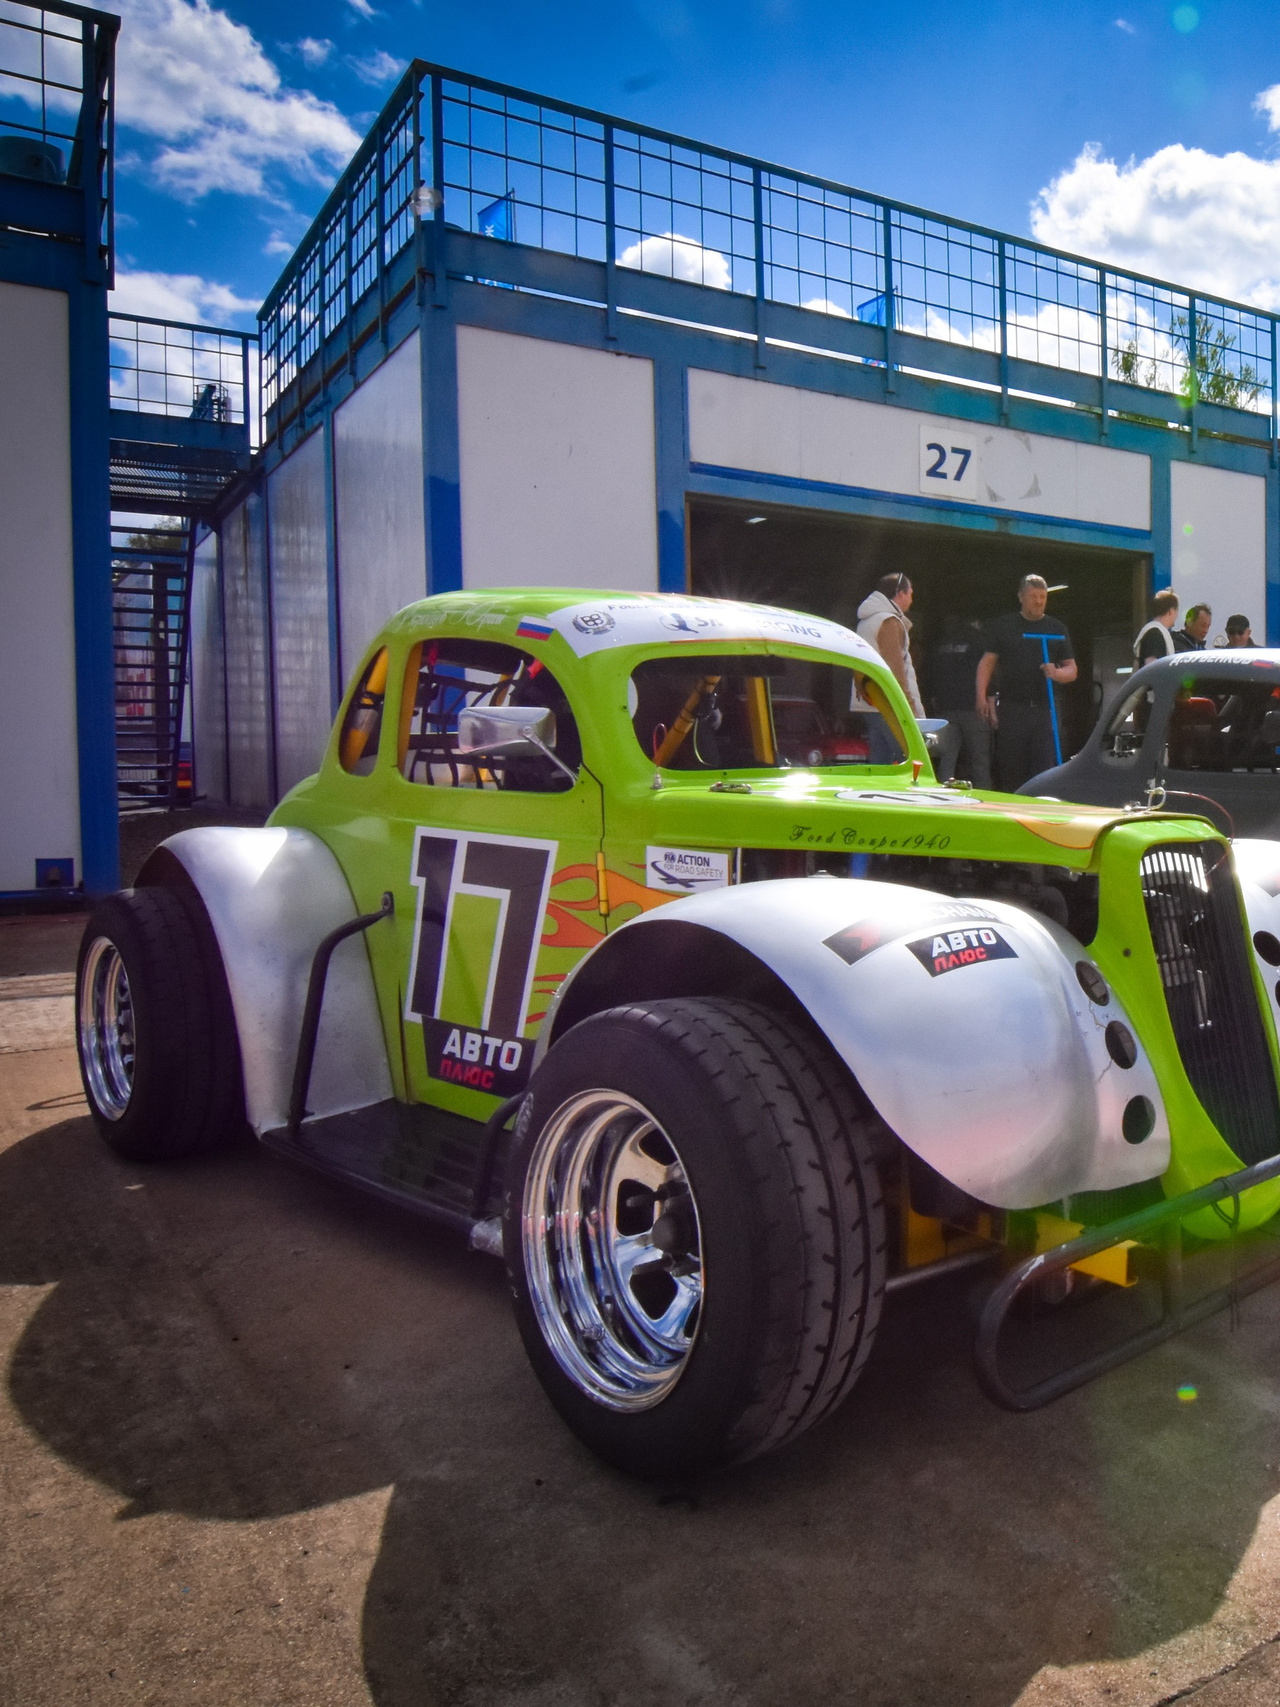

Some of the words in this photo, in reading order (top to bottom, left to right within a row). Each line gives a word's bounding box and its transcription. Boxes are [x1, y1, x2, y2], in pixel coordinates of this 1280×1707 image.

[926, 442, 972, 482] 27
[789, 824, 837, 843] Ford
[664, 852, 675, 862] FIA
[677, 854, 710, 867] ACTION
[675, 866, 695, 875] ROAD
[696, 867, 723, 878] SAFETY
[405, 826, 558, 1038] 17
[932, 929, 997, 958] АВТО
[933, 947, 987, 972] ПЛЮС
[442, 1028, 523, 1071] АВТО
[439, 1059, 495, 1089] ПЛЮС
